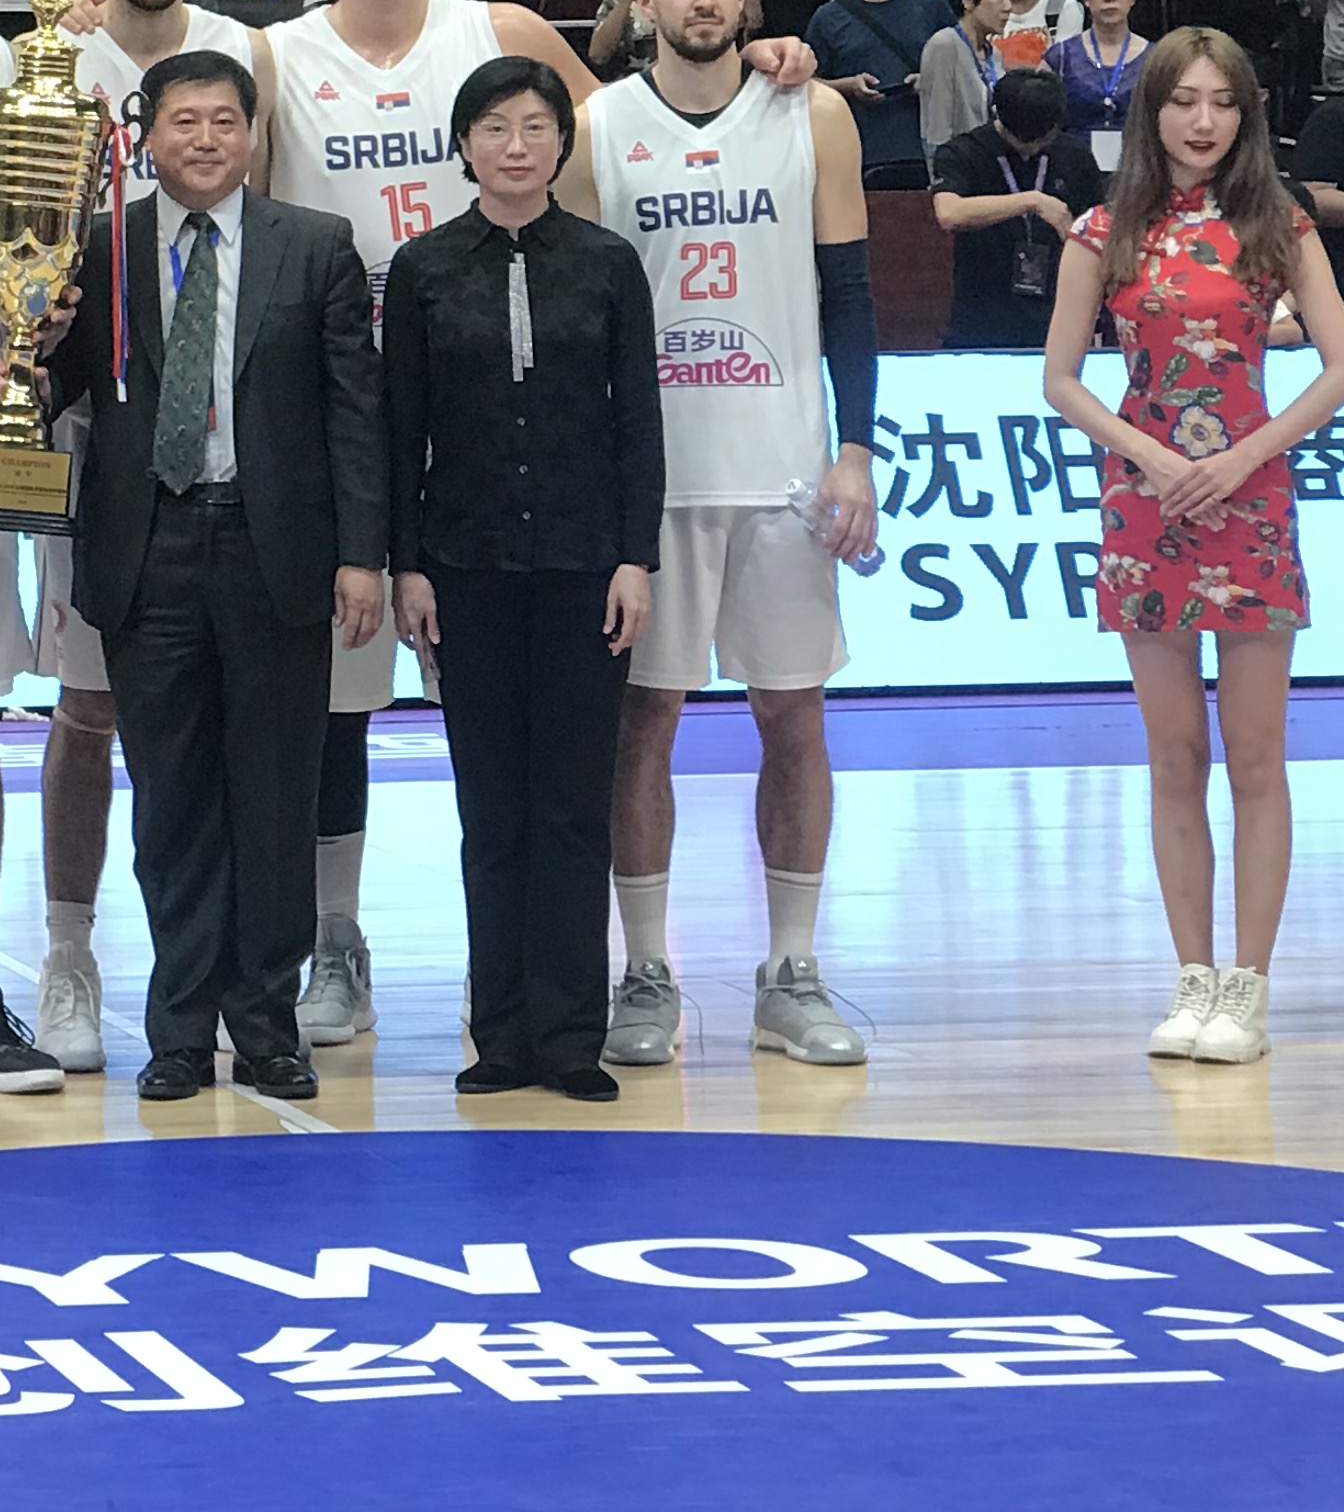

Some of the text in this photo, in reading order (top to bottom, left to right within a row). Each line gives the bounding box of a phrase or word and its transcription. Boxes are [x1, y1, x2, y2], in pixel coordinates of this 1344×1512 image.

[380, 181, 433, 241] 15
[636, 188, 778, 232] SRBIJA
[680, 240, 737, 301] 23
[663, 329, 744, 352] 百岁山
